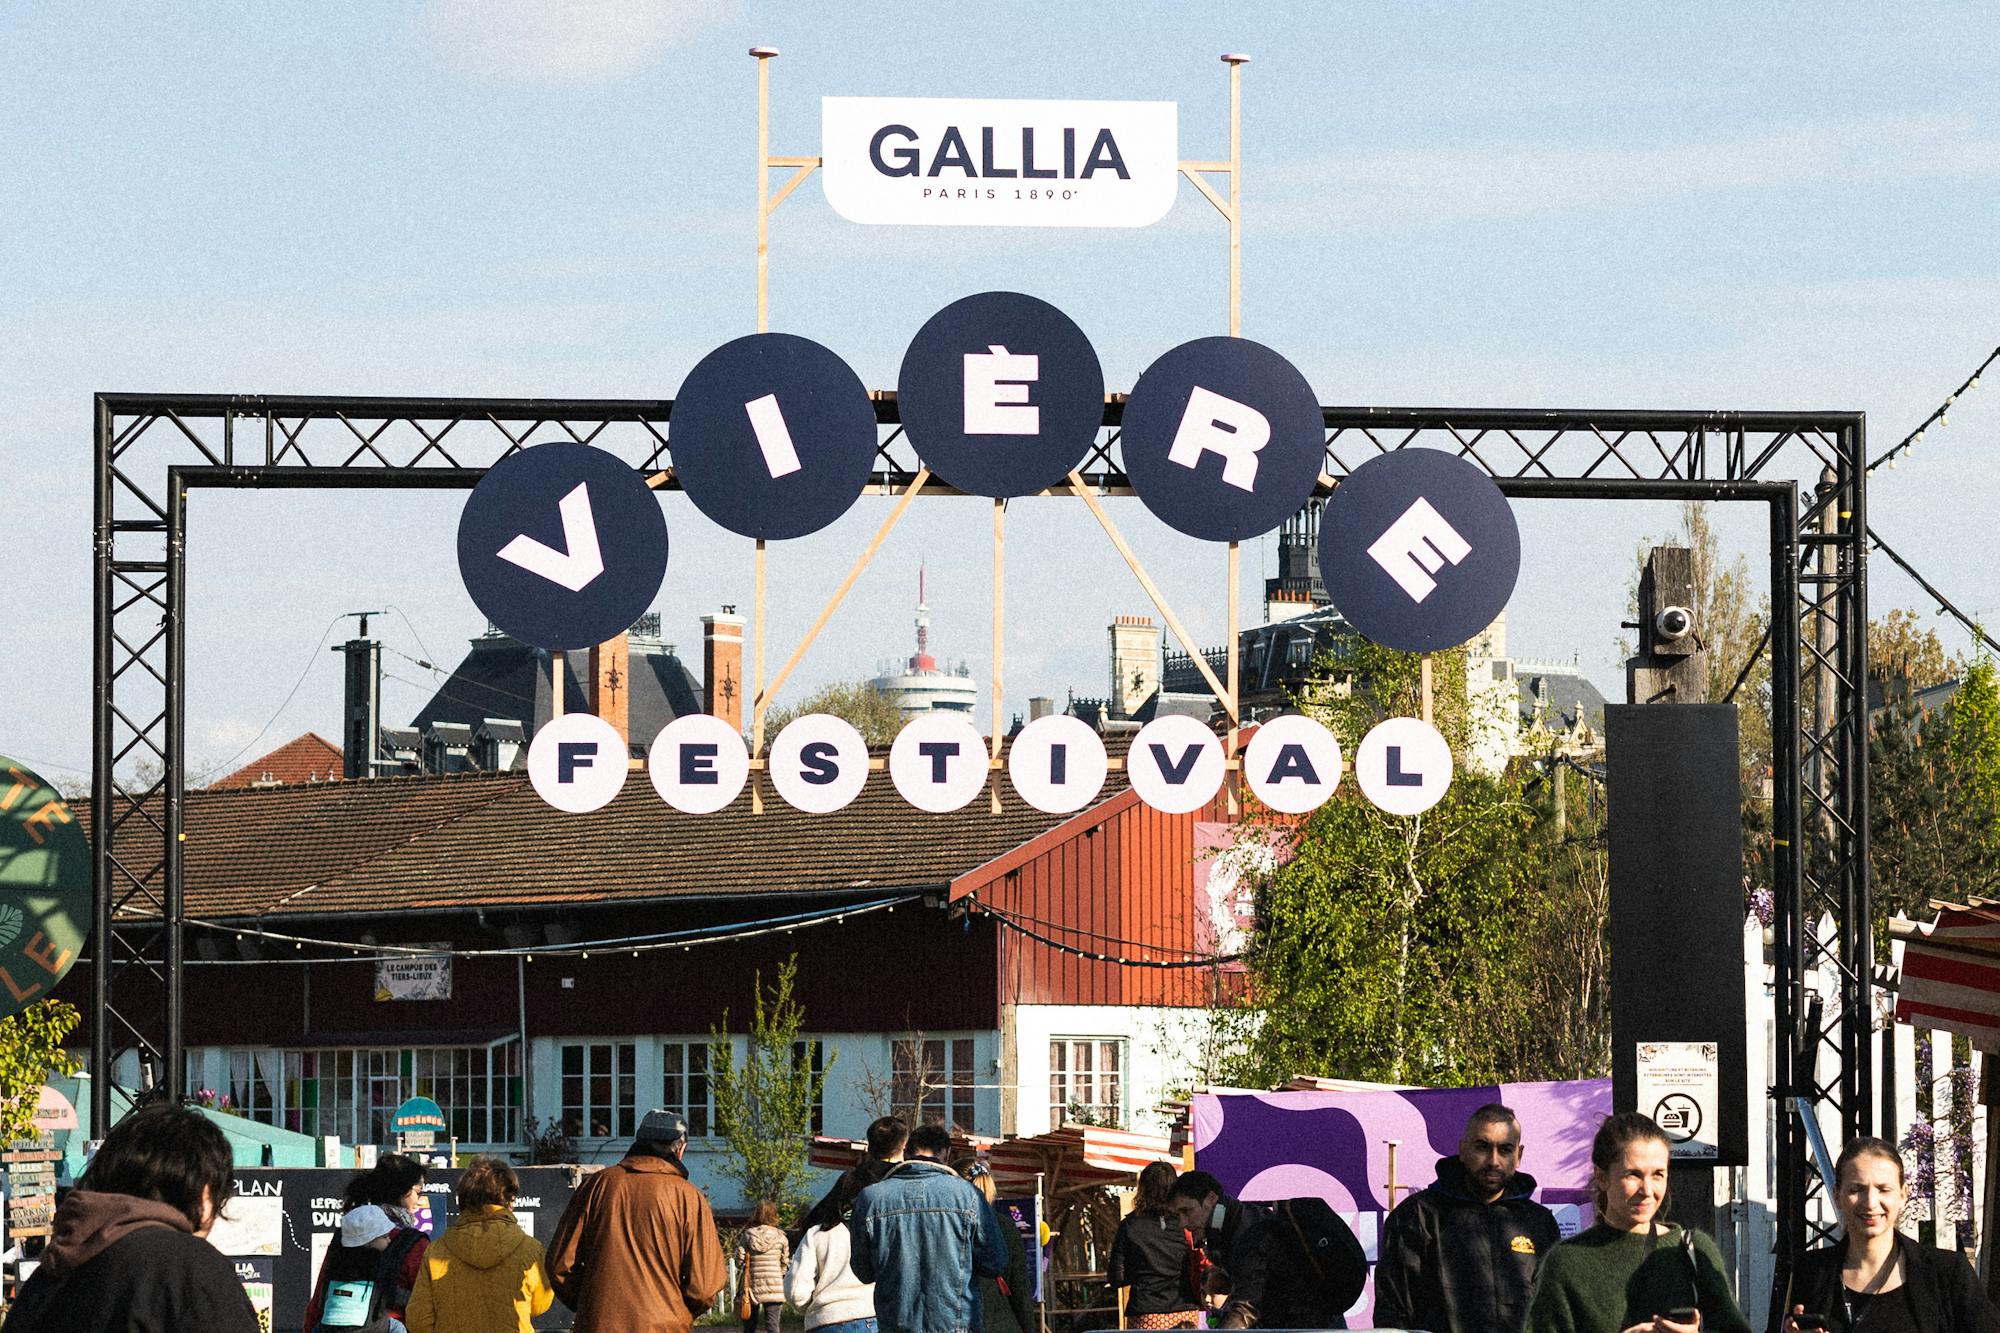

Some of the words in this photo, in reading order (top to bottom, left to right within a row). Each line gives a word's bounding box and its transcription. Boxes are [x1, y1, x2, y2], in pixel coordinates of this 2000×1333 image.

[869, 124, 1131, 180] GALLIA
[923, 188, 996, 199] PARIS
[496, 344, 1473, 604] VIÈRE
[558, 742, 1423, 787] FESTIVAL
[0, 766, 71, 846] TÉ
[386, 964, 396, 972] LE
[424, 963, 437, 971] DES
[235, 1262, 255, 1274] LIA
